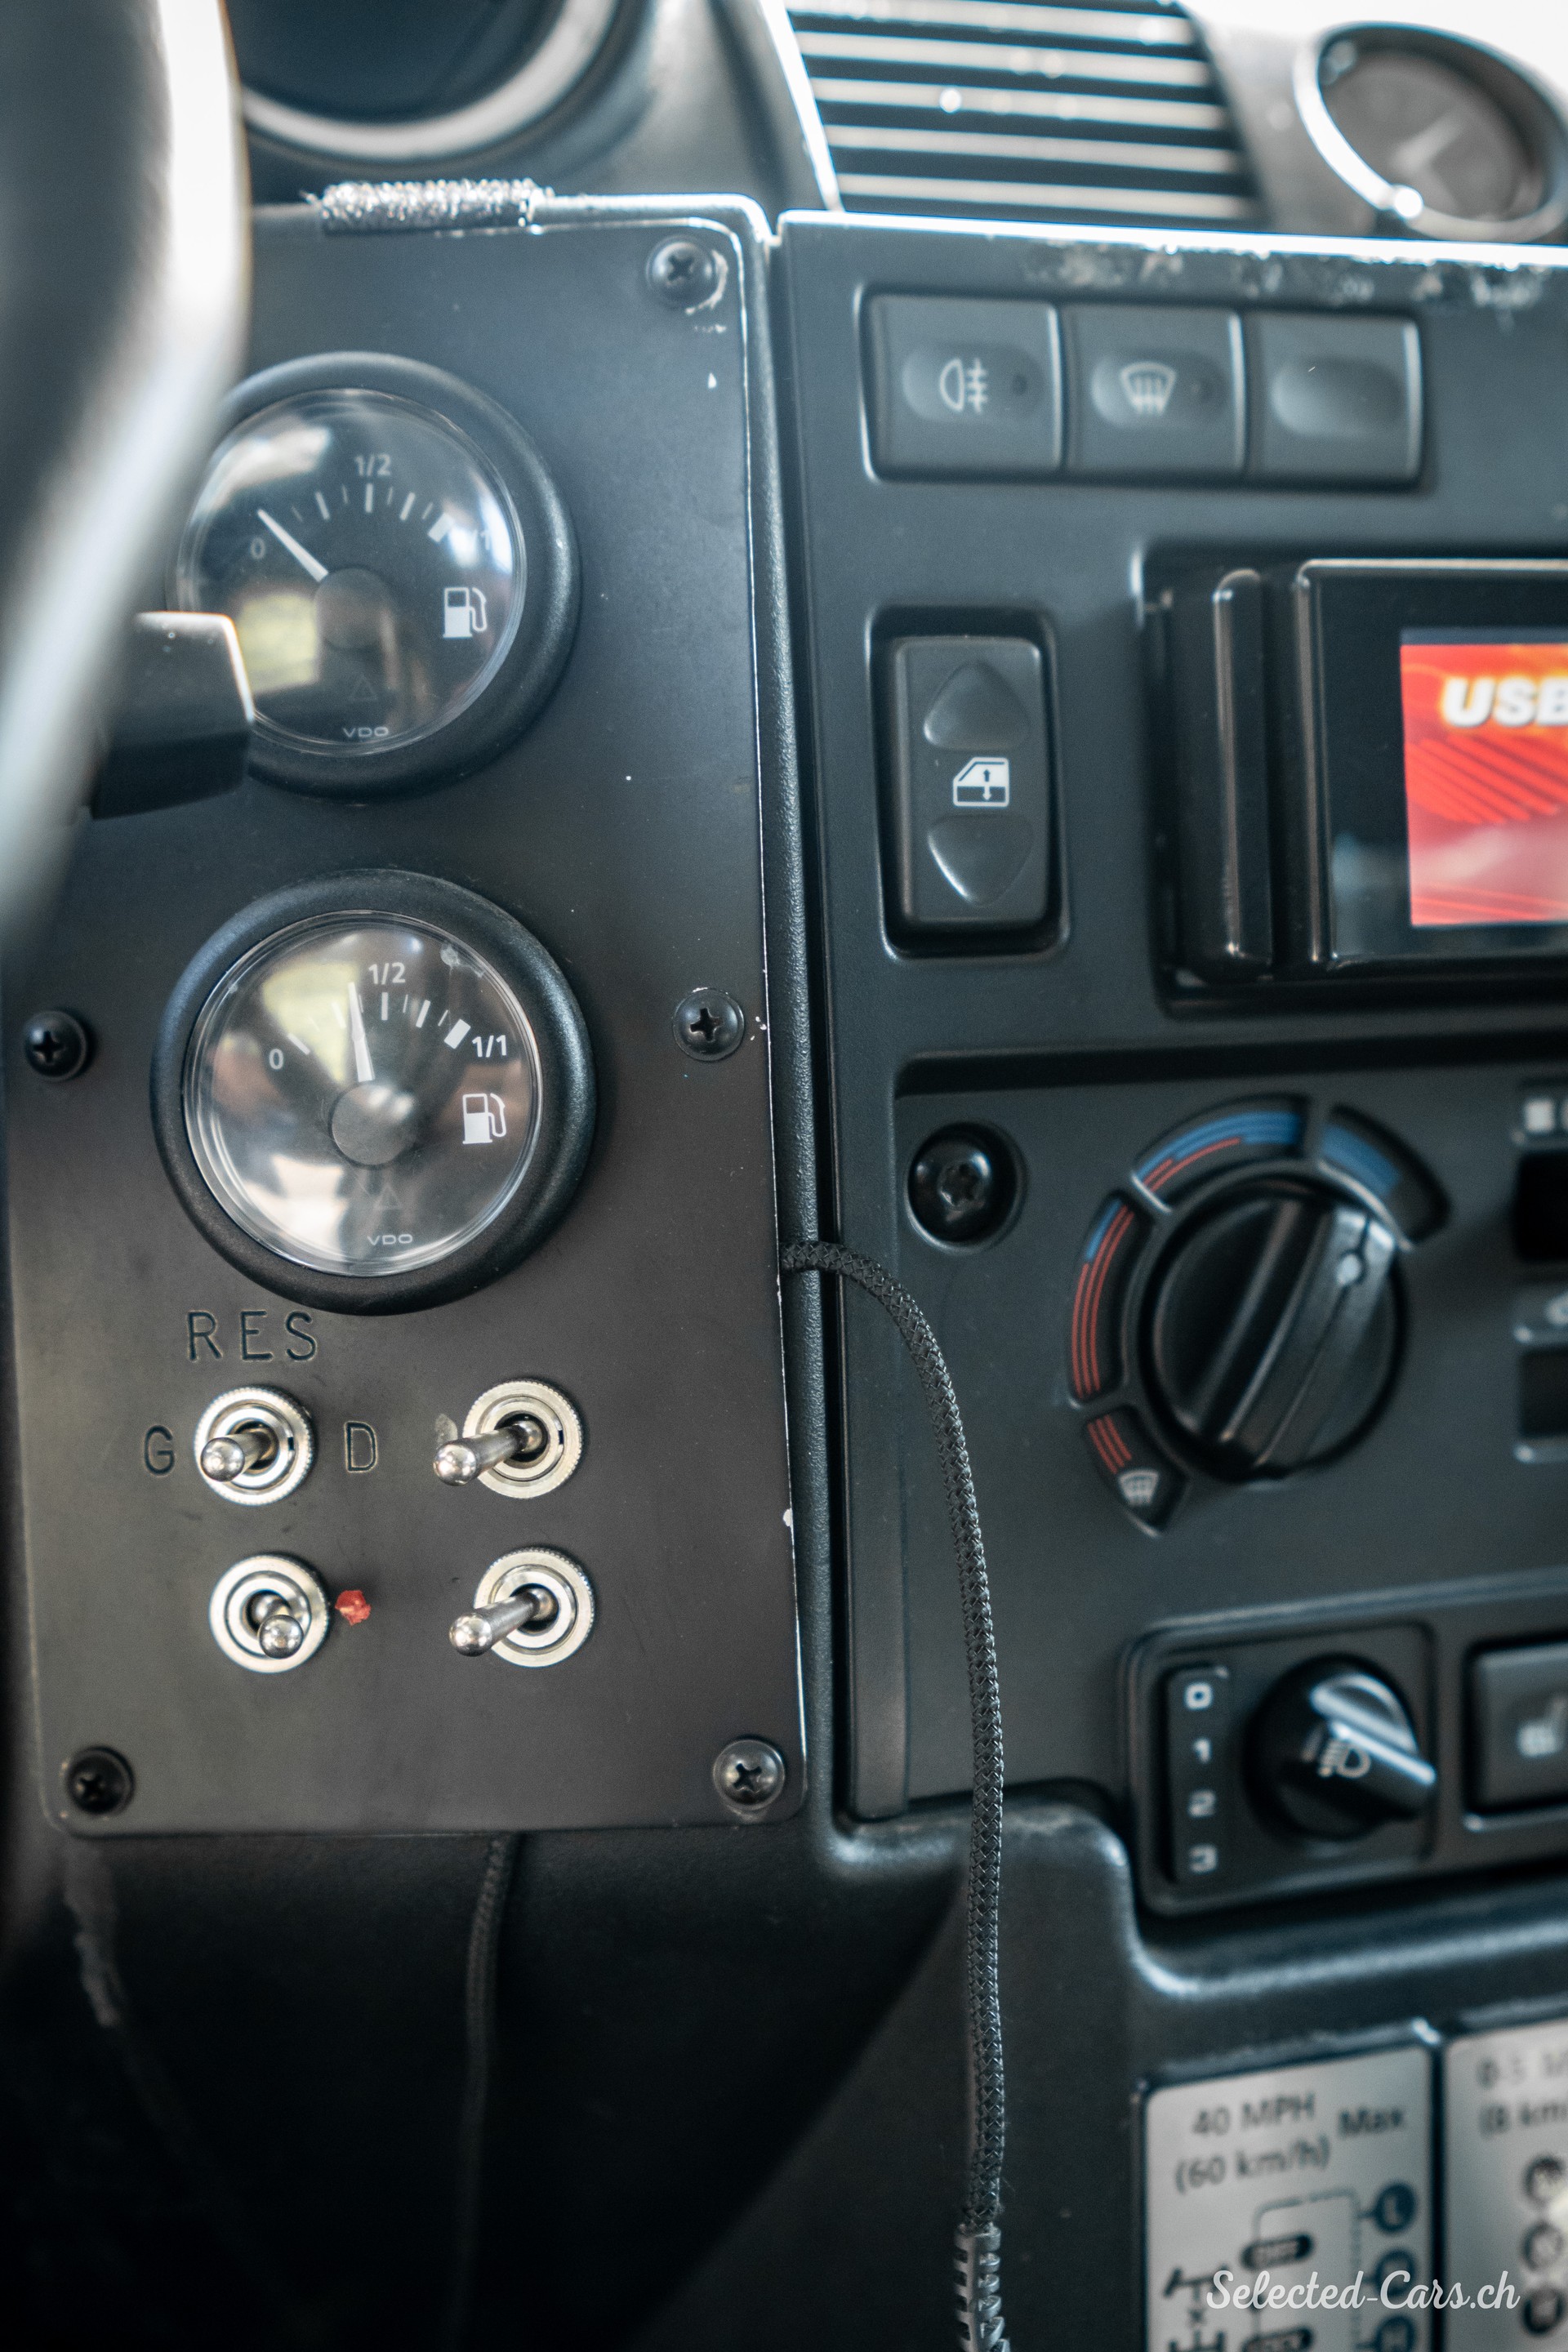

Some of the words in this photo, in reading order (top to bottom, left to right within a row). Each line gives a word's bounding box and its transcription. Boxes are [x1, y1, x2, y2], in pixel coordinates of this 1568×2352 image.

[354, 453, 392, 478] 1/2
[249, 537, 267, 561] 0
[1442, 675, 1568, 728] USB
[343, 725, 390, 739] VDO
[368, 961, 407, 986] 1/2
[268, 1048, 284, 1071] 0
[471, 1034, 508, 1058] 1/1
[366, 1233, 413, 1246] VDO
[185, 1309, 318, 1362] RES
[143, 1424, 176, 1477] G
[343, 1420, 379, 1473] D
[1187, 1789, 1217, 1820] 2
[1192, 2105, 1232, 2138] 40
[1240, 2091, 1316, 2132] MPH
[1174, 2151, 1228, 2196] (60
[1235, 2132, 1332, 2182] km/h)
